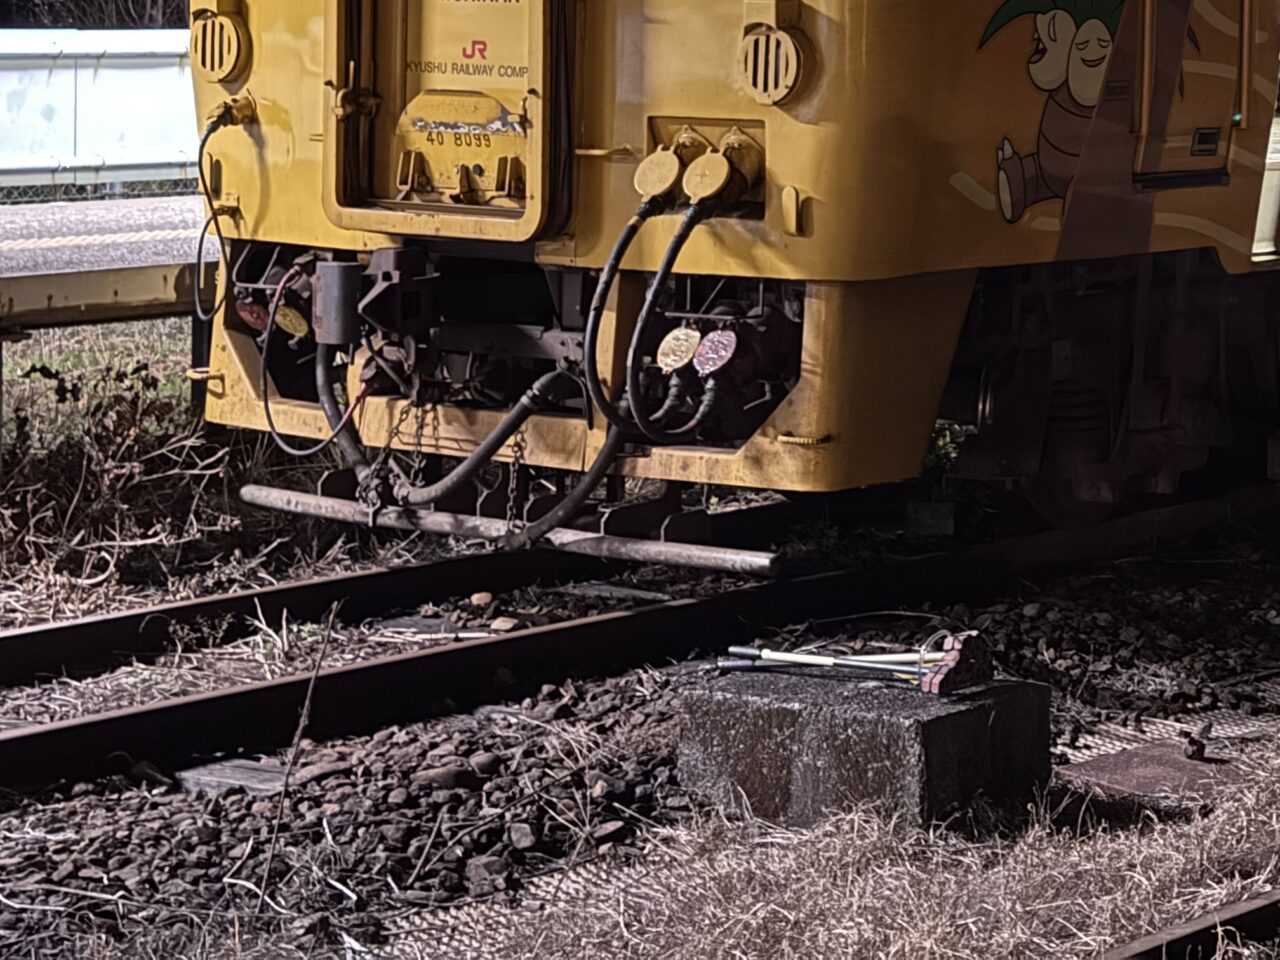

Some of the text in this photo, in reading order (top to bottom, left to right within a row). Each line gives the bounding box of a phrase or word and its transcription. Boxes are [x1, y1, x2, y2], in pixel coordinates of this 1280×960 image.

[462, 40, 488, 60] JR
[406, 61, 447, 74] KYUSHU
[451, 63, 494, 76] RAILWAY
[426, 131, 491, 148] 40 8099
